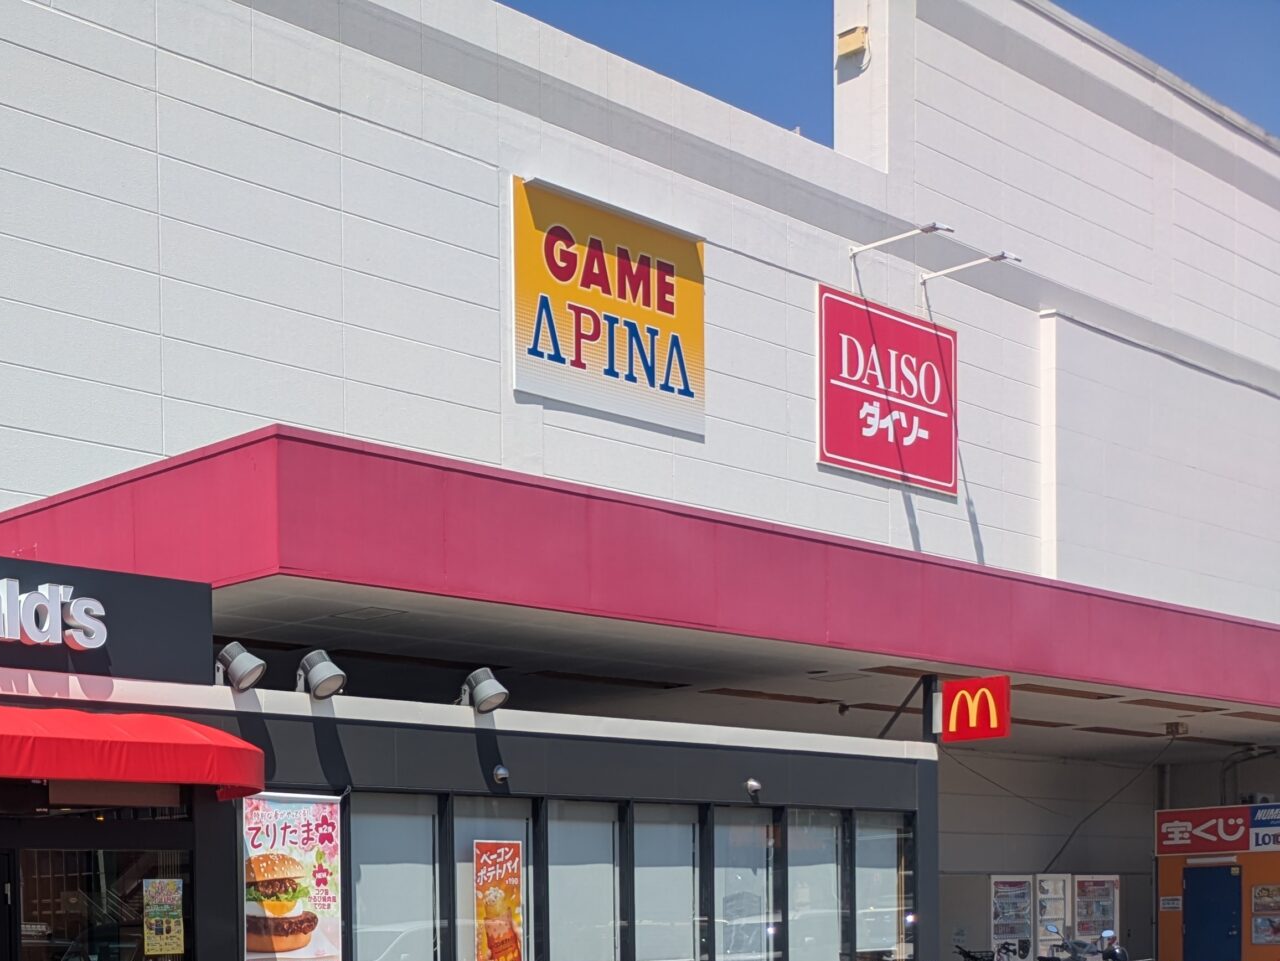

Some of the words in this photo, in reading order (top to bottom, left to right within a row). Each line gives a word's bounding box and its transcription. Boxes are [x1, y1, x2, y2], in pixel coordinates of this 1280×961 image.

[544, 225, 676, 316] GAME
[839, 332, 941, 405] DAISO
[859, 401, 929, 447] ダイソー
[248, 820, 314, 849] てりたま
[1161, 817, 1245, 845] 宝くじ
[480, 846, 513, 864] ベーコン
[477, 857, 519, 885] ポテトパイ
